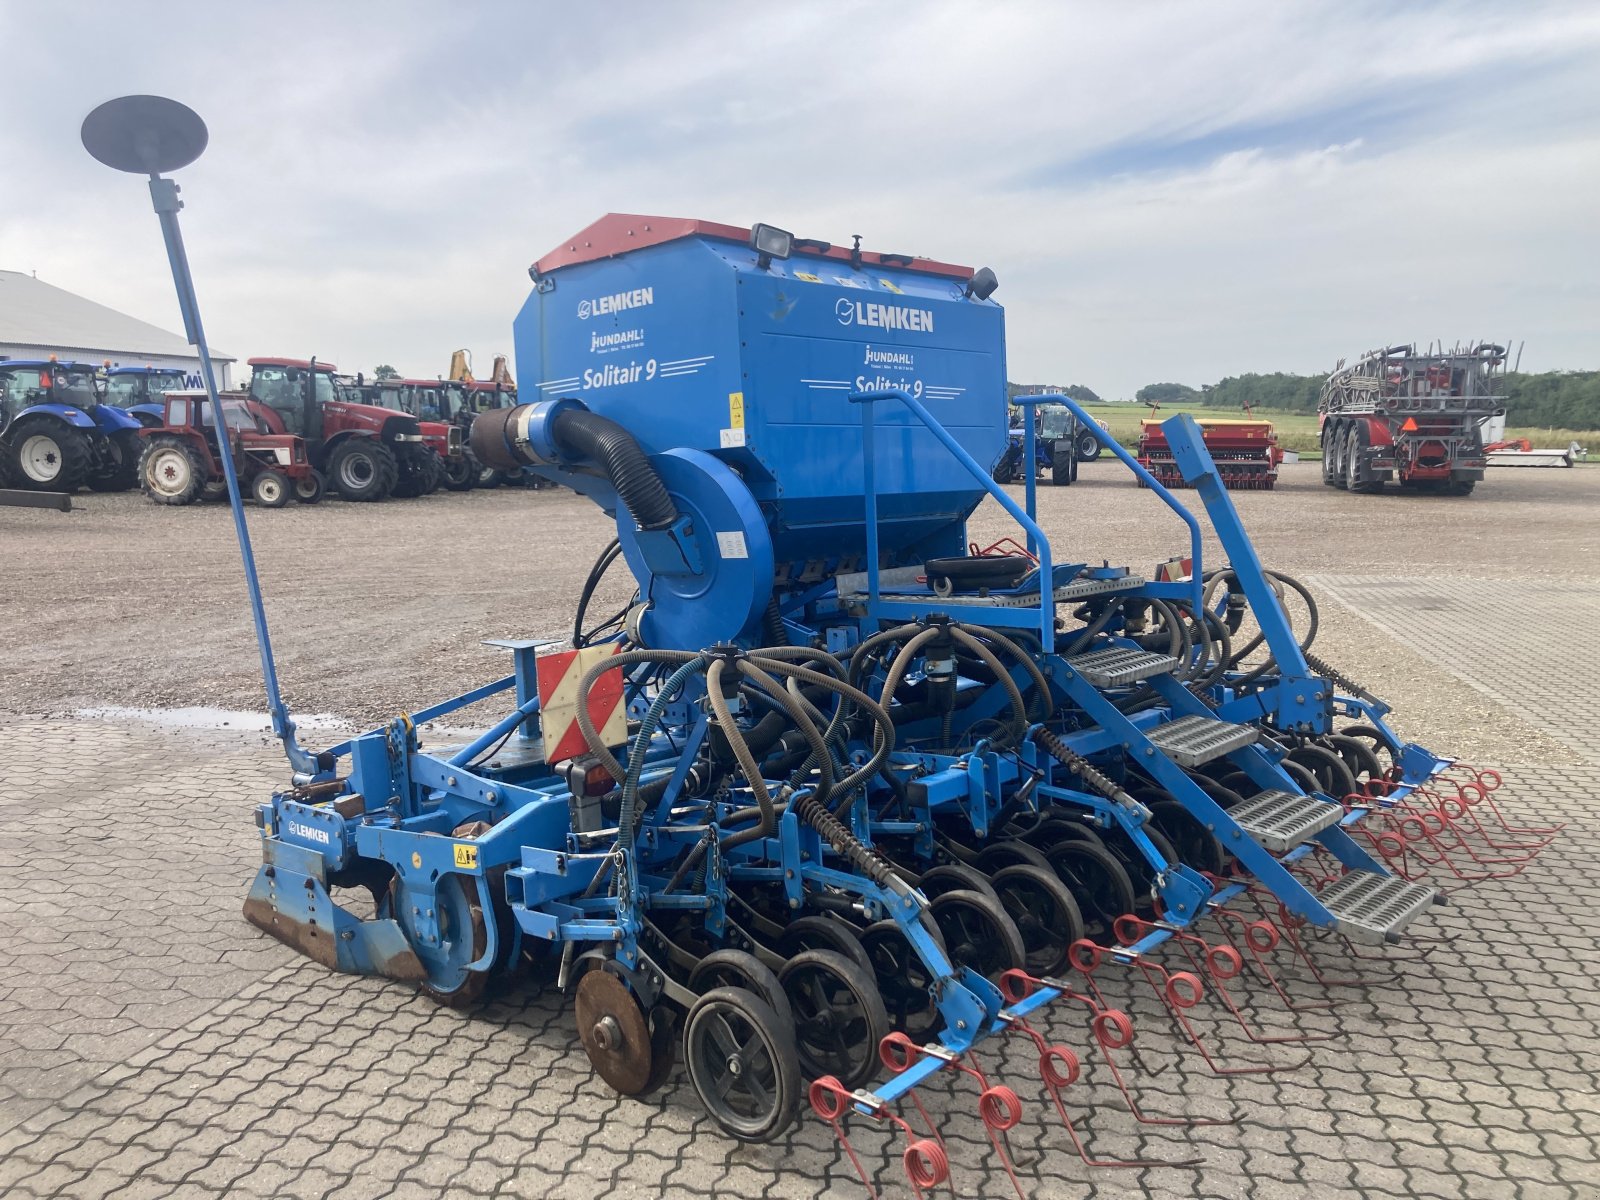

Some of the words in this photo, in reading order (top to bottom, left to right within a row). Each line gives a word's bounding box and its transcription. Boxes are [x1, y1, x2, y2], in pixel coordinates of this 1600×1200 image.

[592, 287, 653, 316] LEMKEN
[856, 302, 933, 333] LEMKEN
[583, 361, 643, 390] Solitair
[645, 358, 657, 381] 9
[914, 380, 923, 399] 9
[296, 823, 329, 845] LEMKEN
